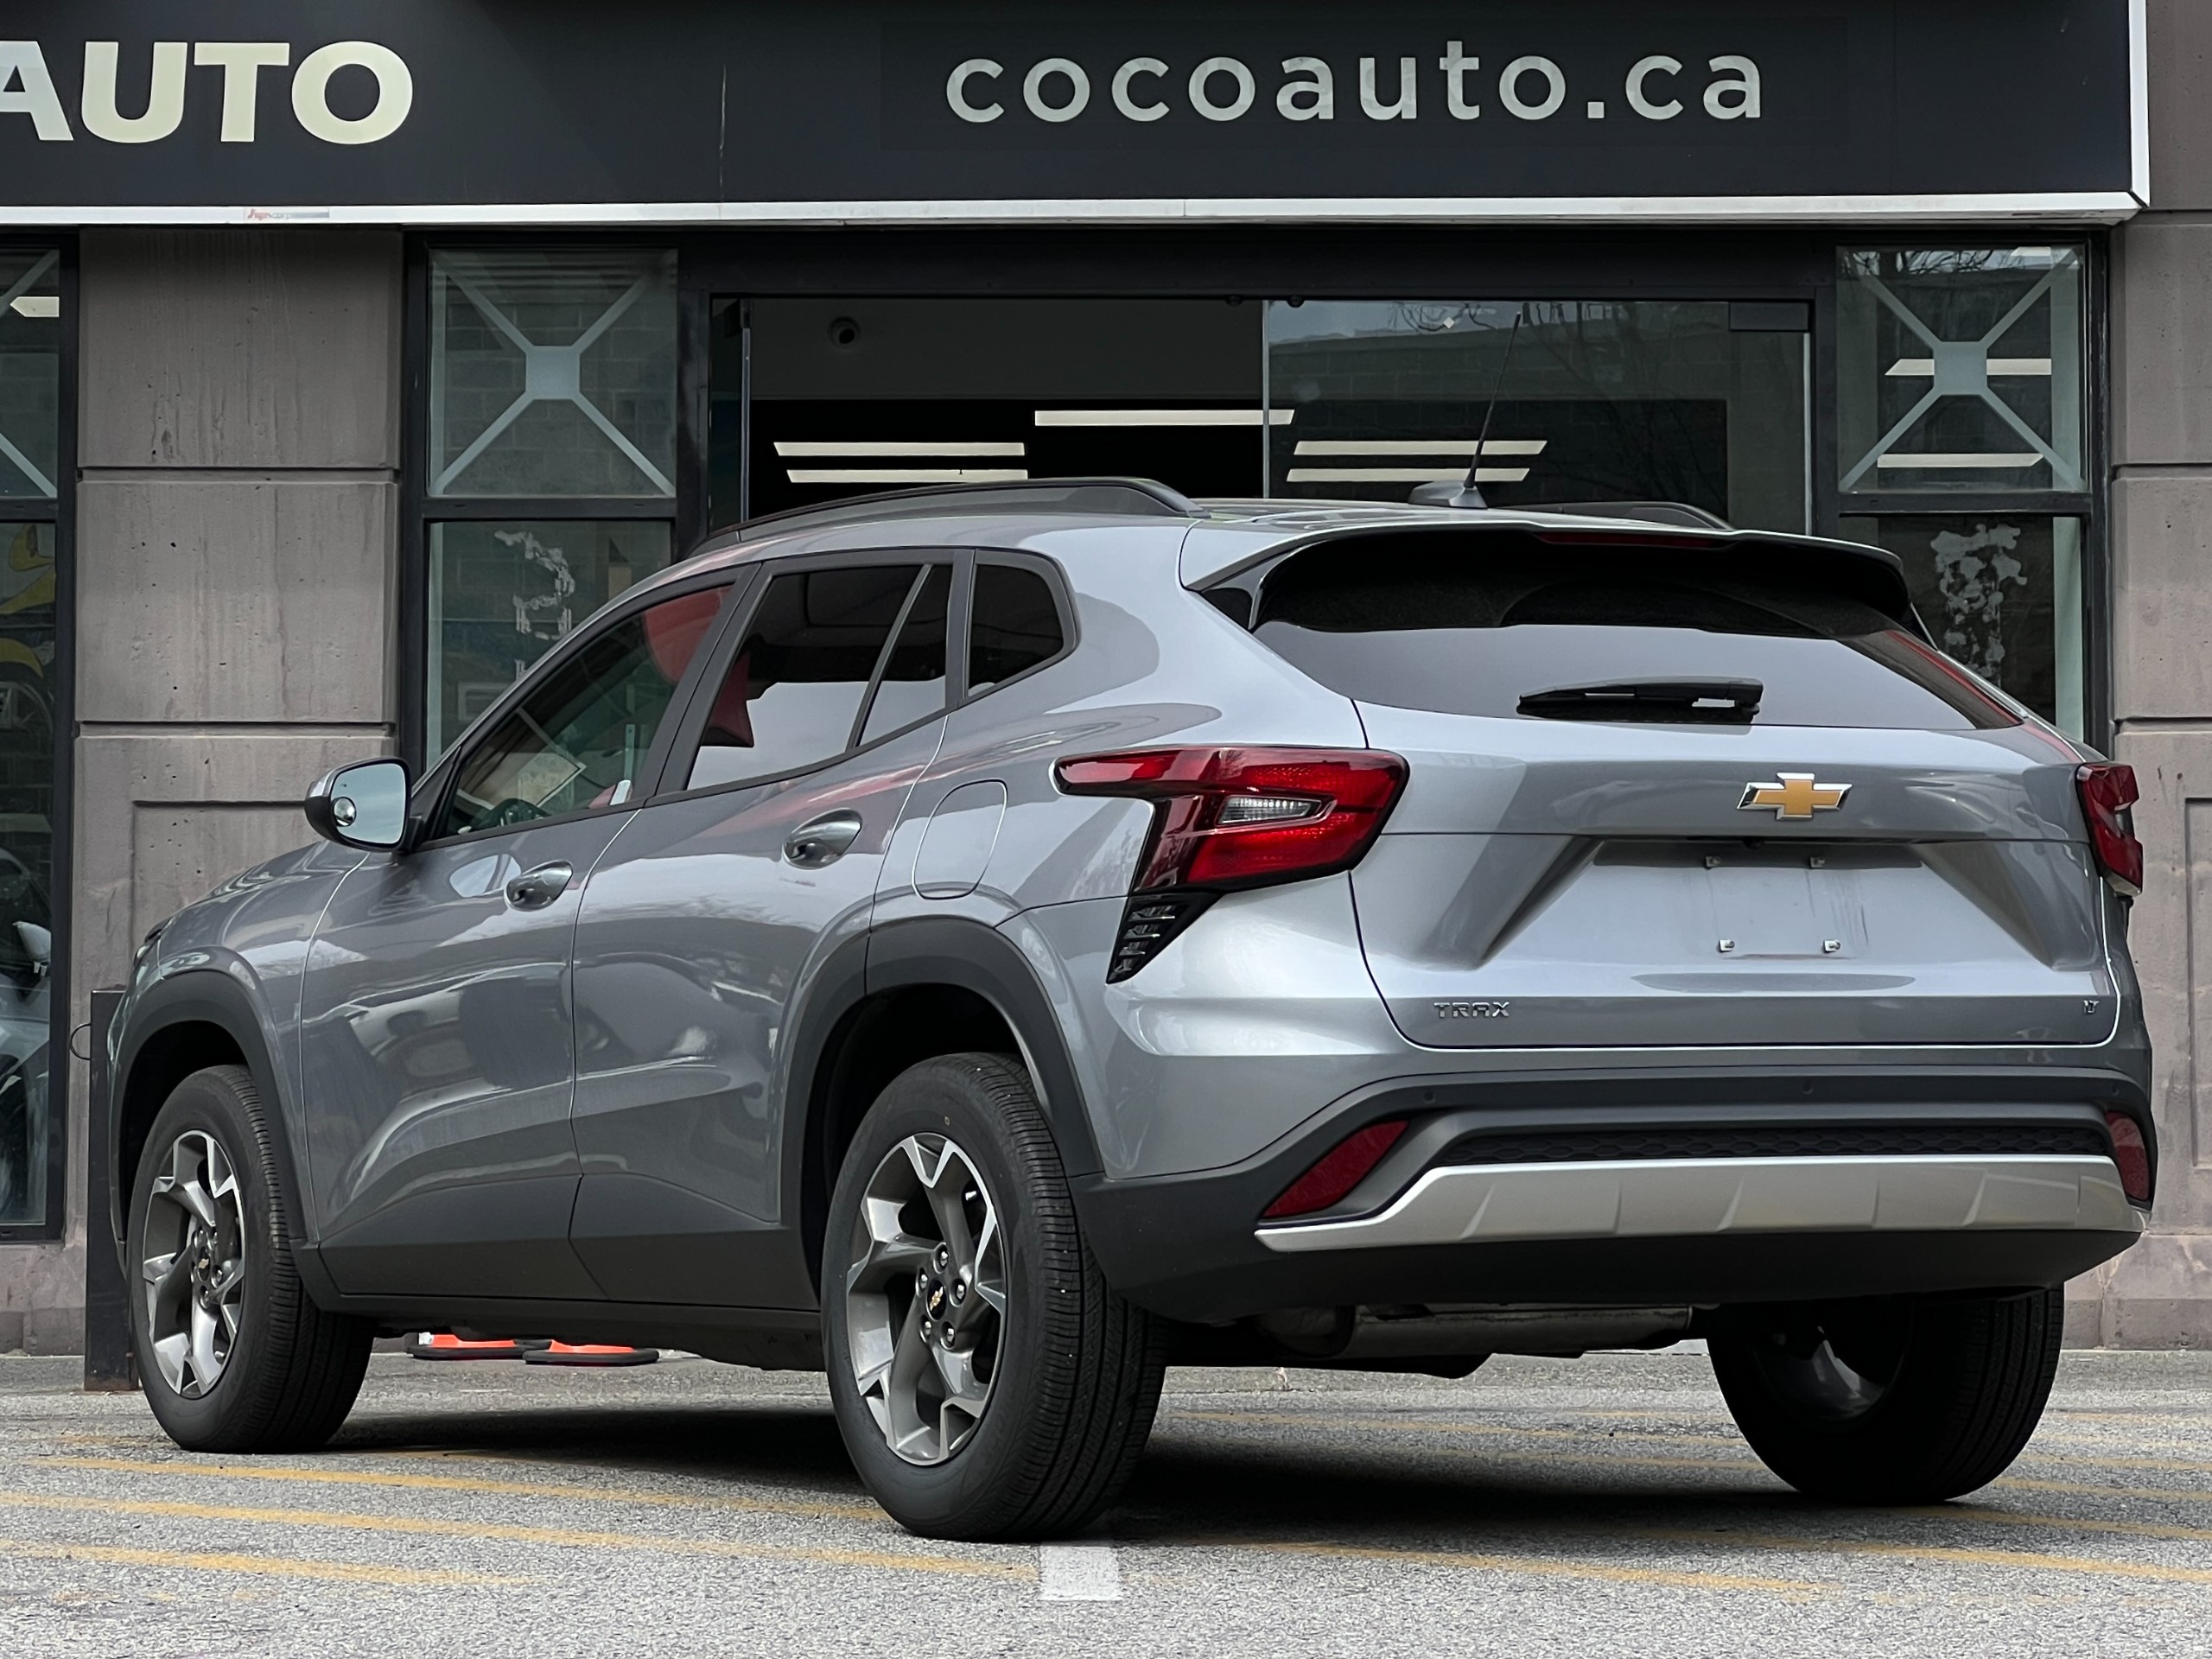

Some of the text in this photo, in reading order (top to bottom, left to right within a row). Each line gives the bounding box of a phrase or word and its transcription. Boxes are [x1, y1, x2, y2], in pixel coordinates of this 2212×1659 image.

[0, 41, 413, 144] AUTO
[946, 41, 1762, 123] cocoauto.ca
[1433, 1001, 1510, 1018] TRAX
